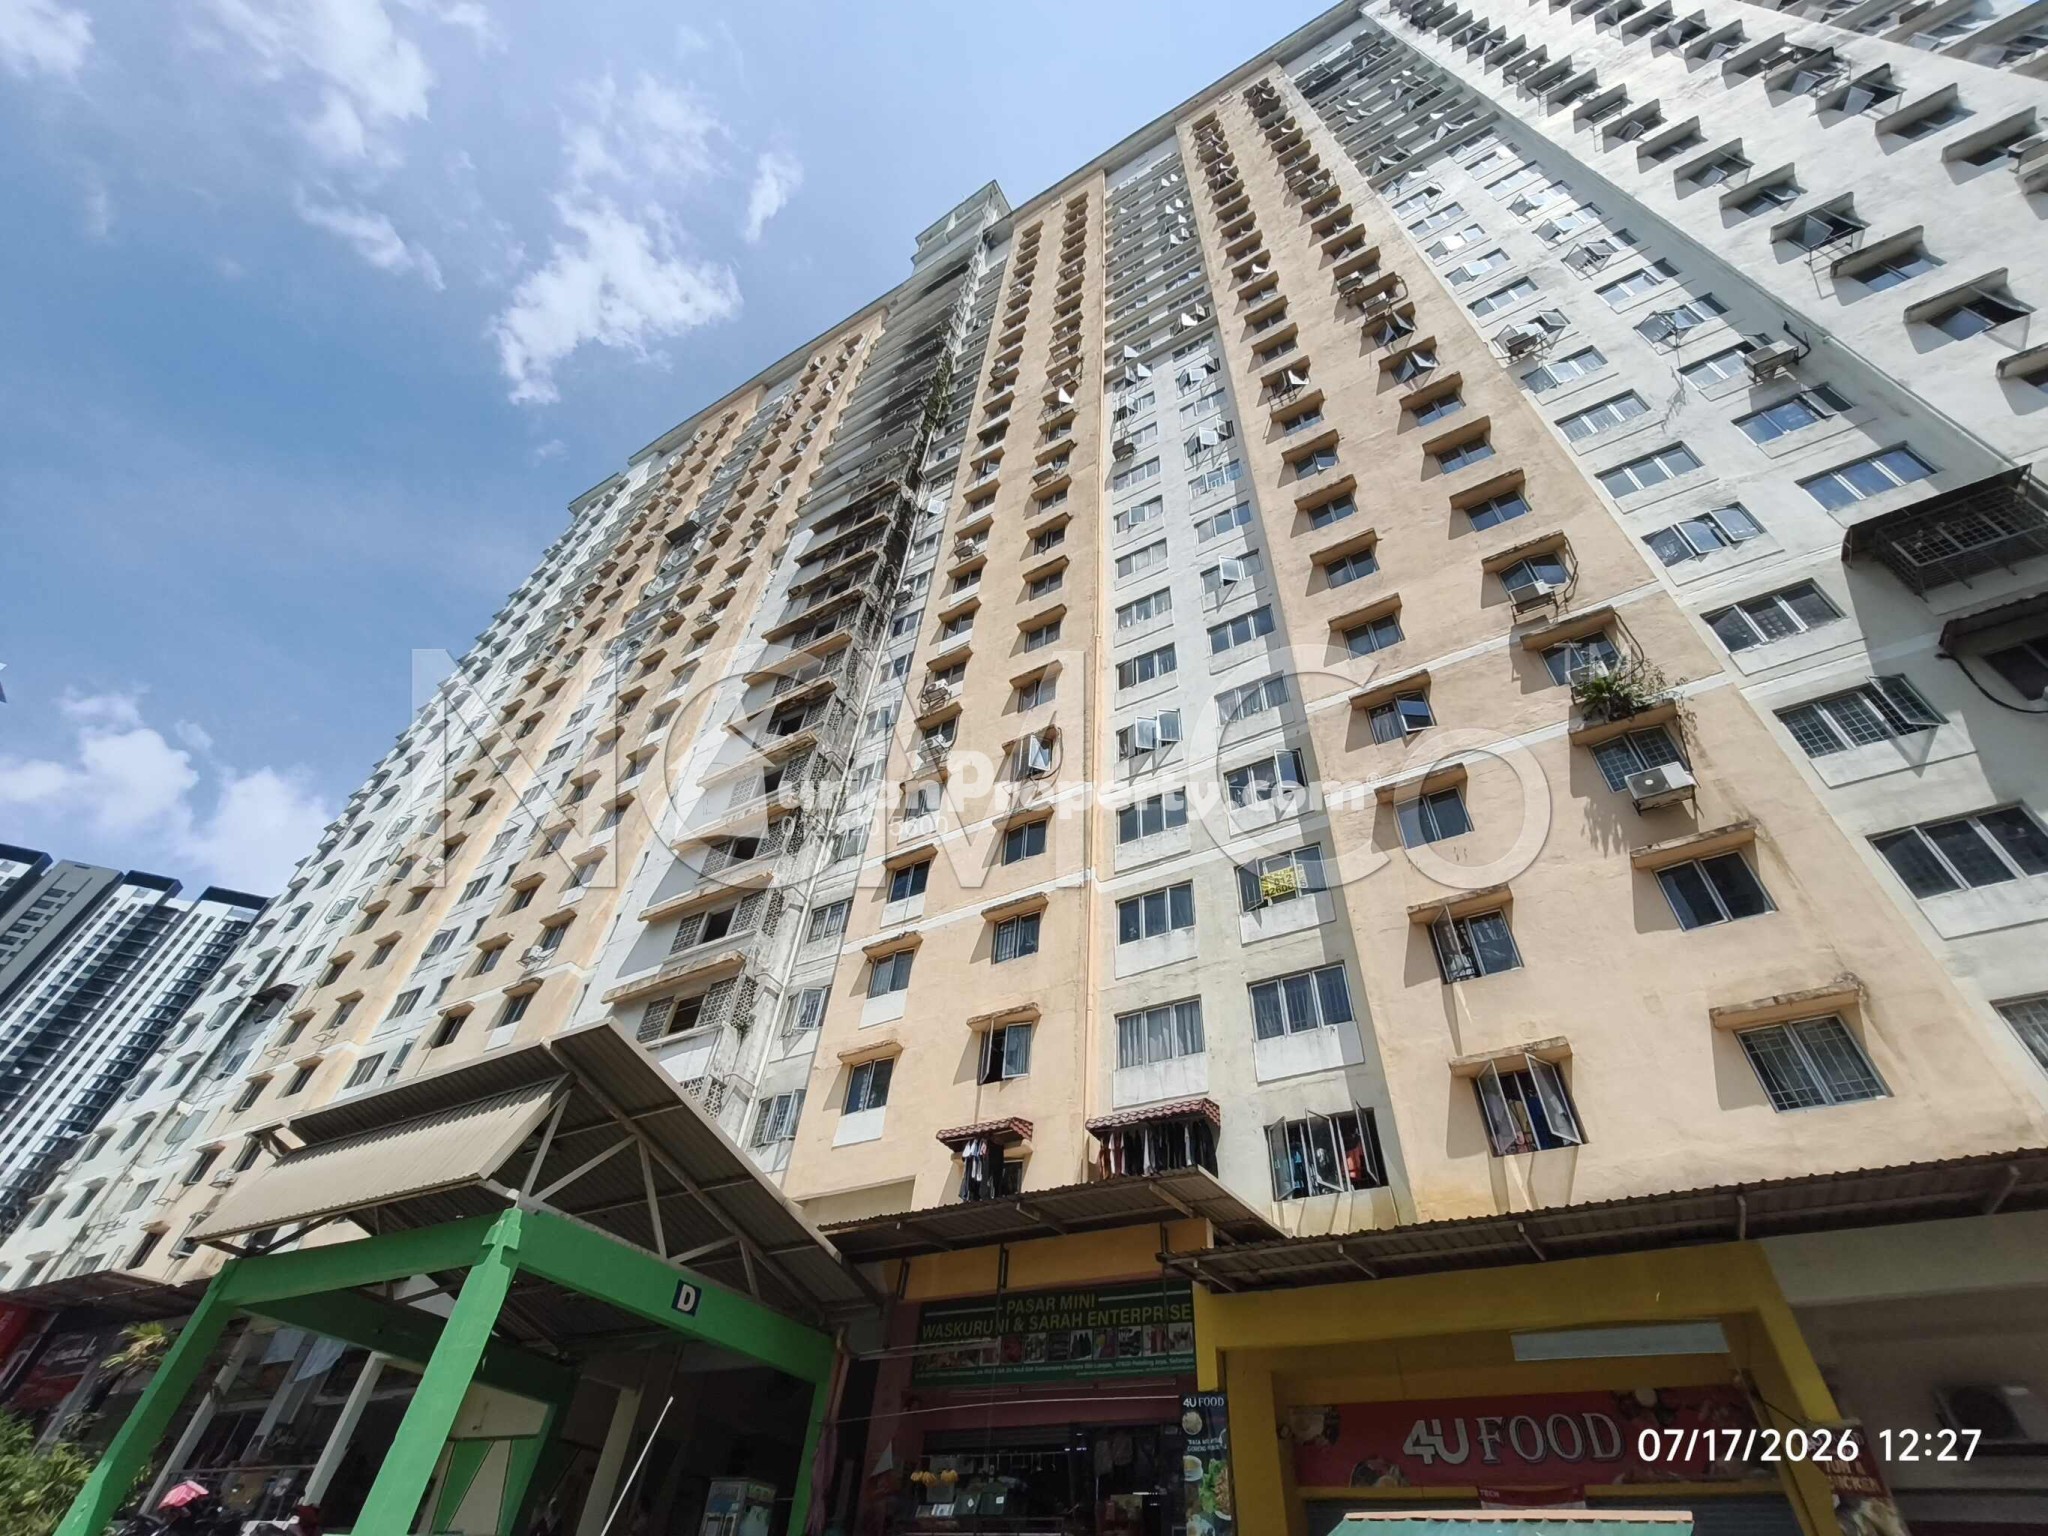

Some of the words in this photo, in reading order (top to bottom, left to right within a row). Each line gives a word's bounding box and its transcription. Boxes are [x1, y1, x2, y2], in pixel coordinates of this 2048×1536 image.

[677, 1284, 696, 1312] D
[1006, 1297, 1056, 1315] PASAR
[1060, 1294, 1096, 1311] MINI
[1013, 1316, 1024, 1332] &
[1029, 1314, 1083, 1332] SARAH
[1087, 1303, 1192, 1327] ENTERPRISE
[1182, 1397, 1198, 1408] 4U
[1199, 1396, 1225, 1408] FOOD
[1402, 1418, 1471, 1465] 4U
[1475, 1412, 1625, 1463] FOOD
